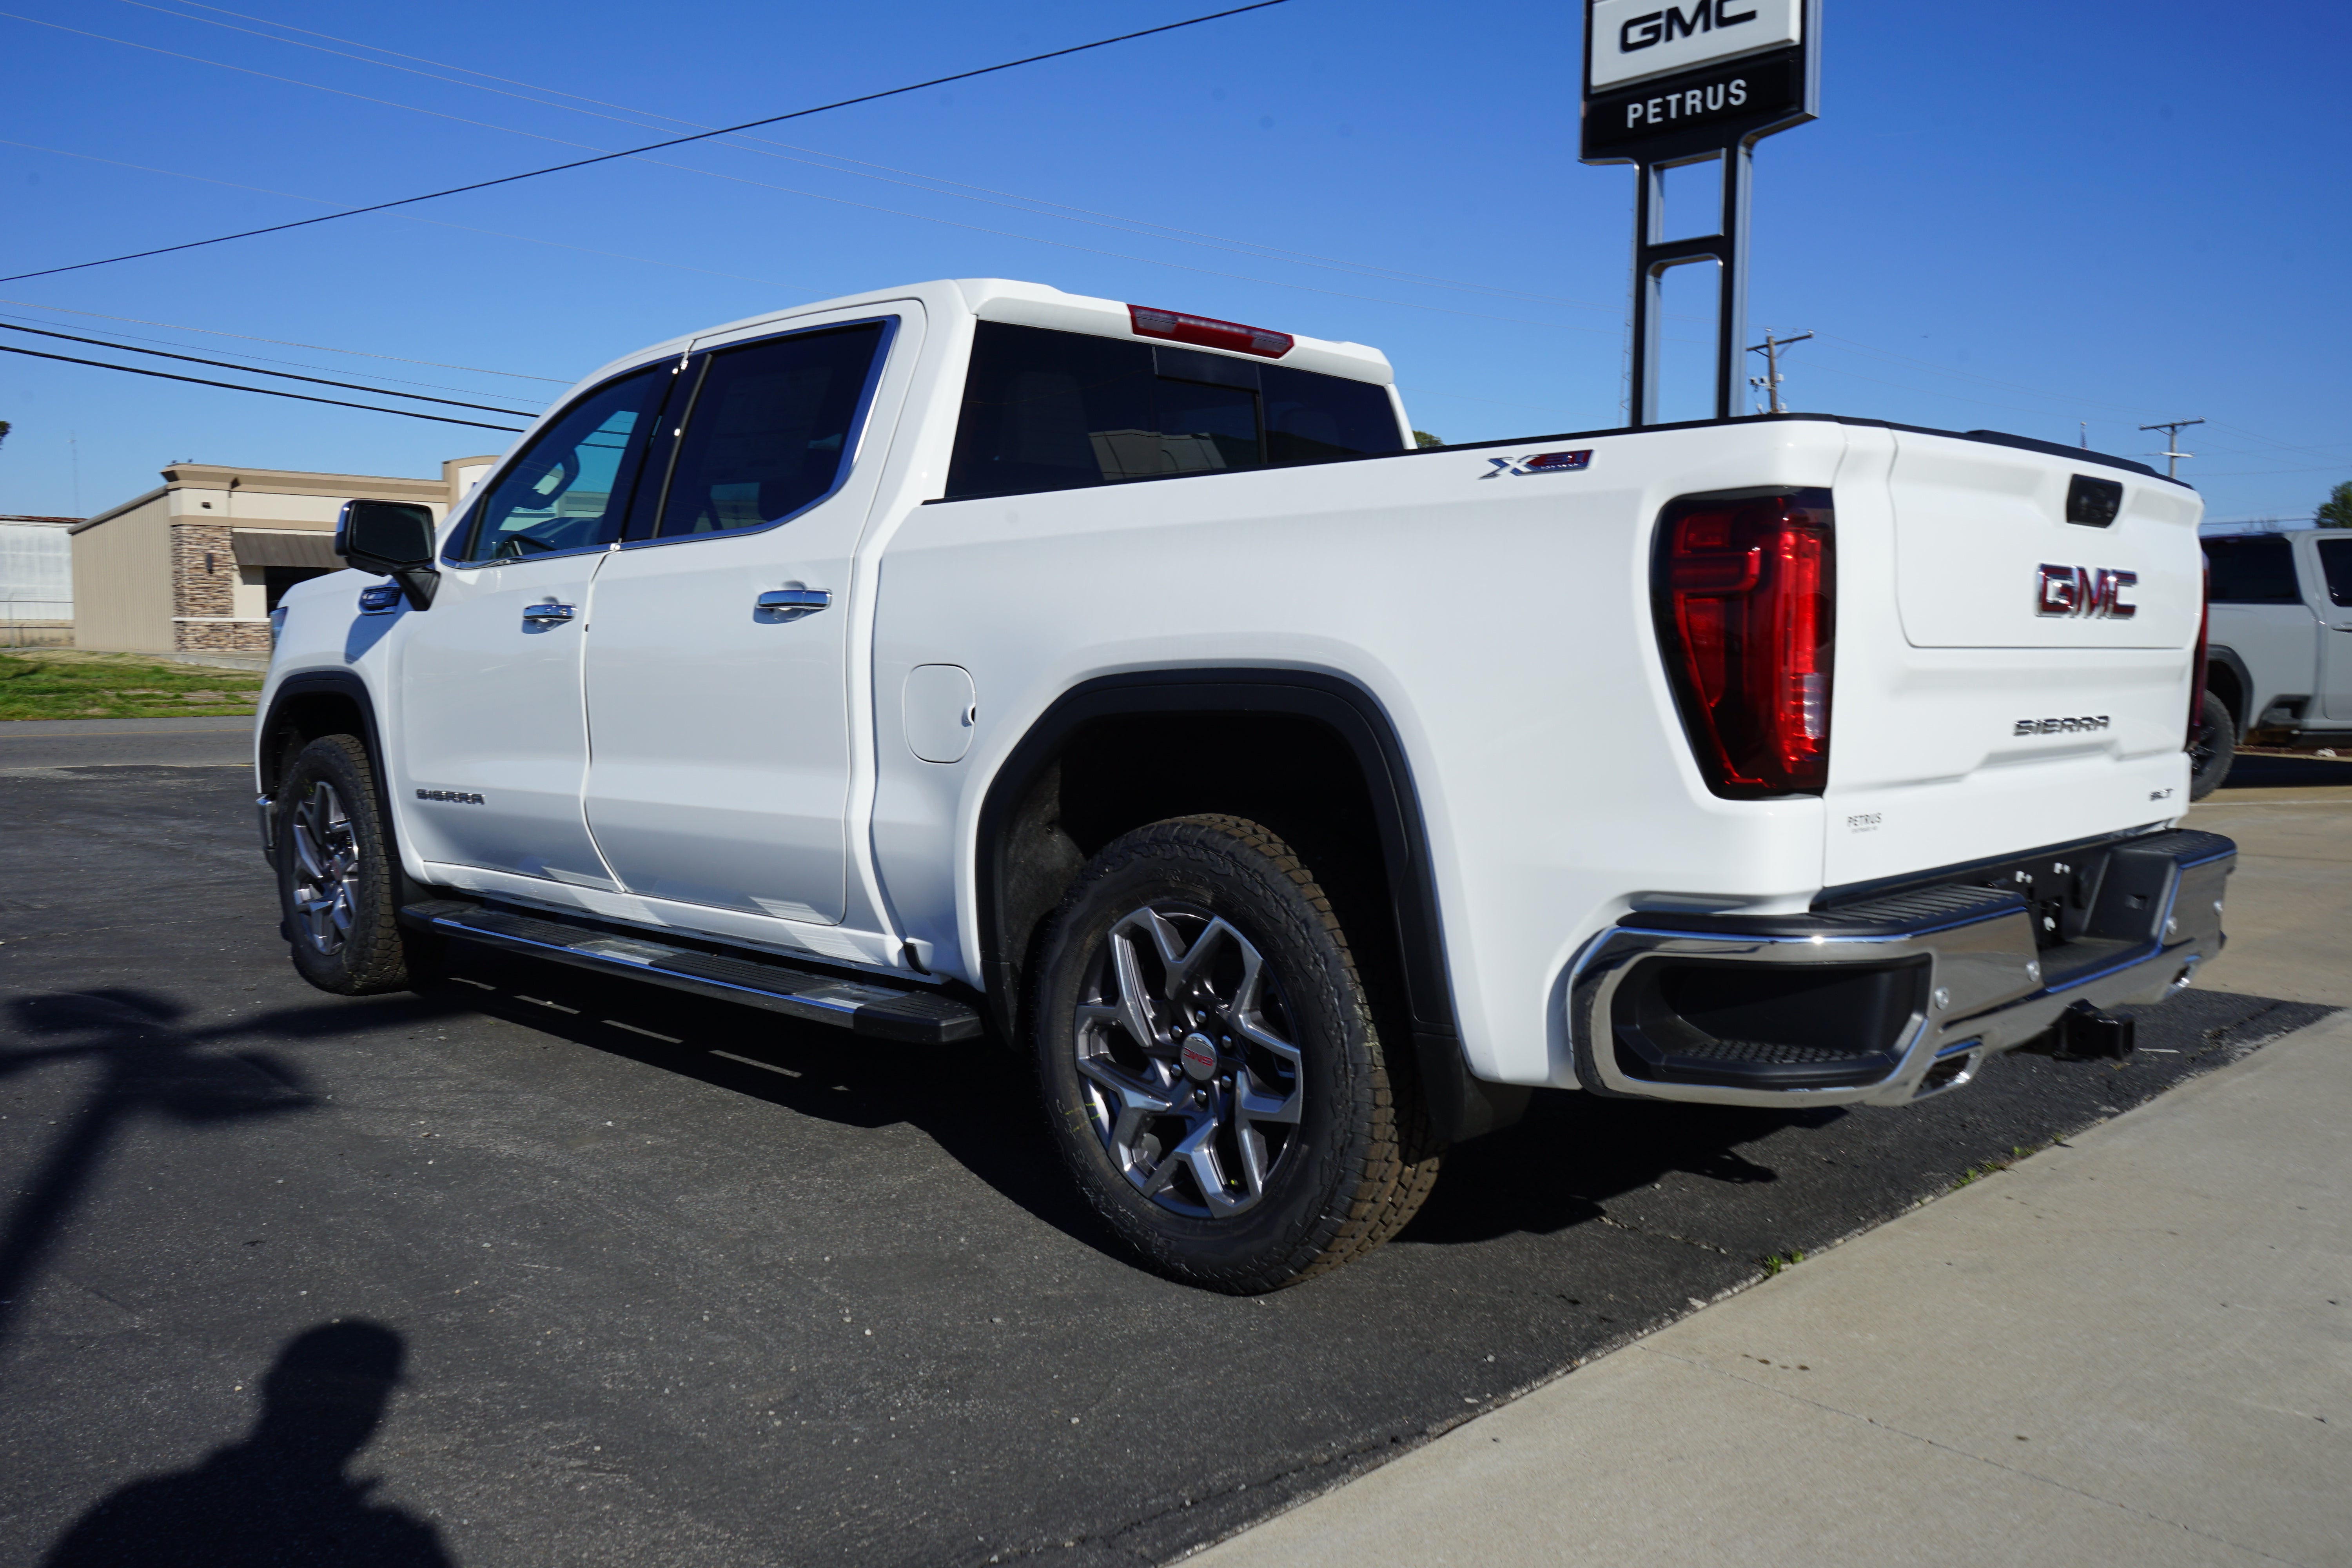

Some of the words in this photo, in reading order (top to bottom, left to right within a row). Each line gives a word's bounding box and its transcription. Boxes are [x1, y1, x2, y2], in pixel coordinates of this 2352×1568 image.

[1620, 0, 1758, 53] GMC
[1626, 79, 1747, 128] PETRUS
[1477, 449, 1593, 480] X31
[2036, 563, 2138, 619] GMC
[2013, 715, 2110, 737] SIERRA
[416, 789, 486, 805] SIERRA
[1847, 812, 1882, 828] PETRUS
[1149, 866, 1306, 993] BRIDGESTONE
[1183, 1047, 1214, 1067] GMC
